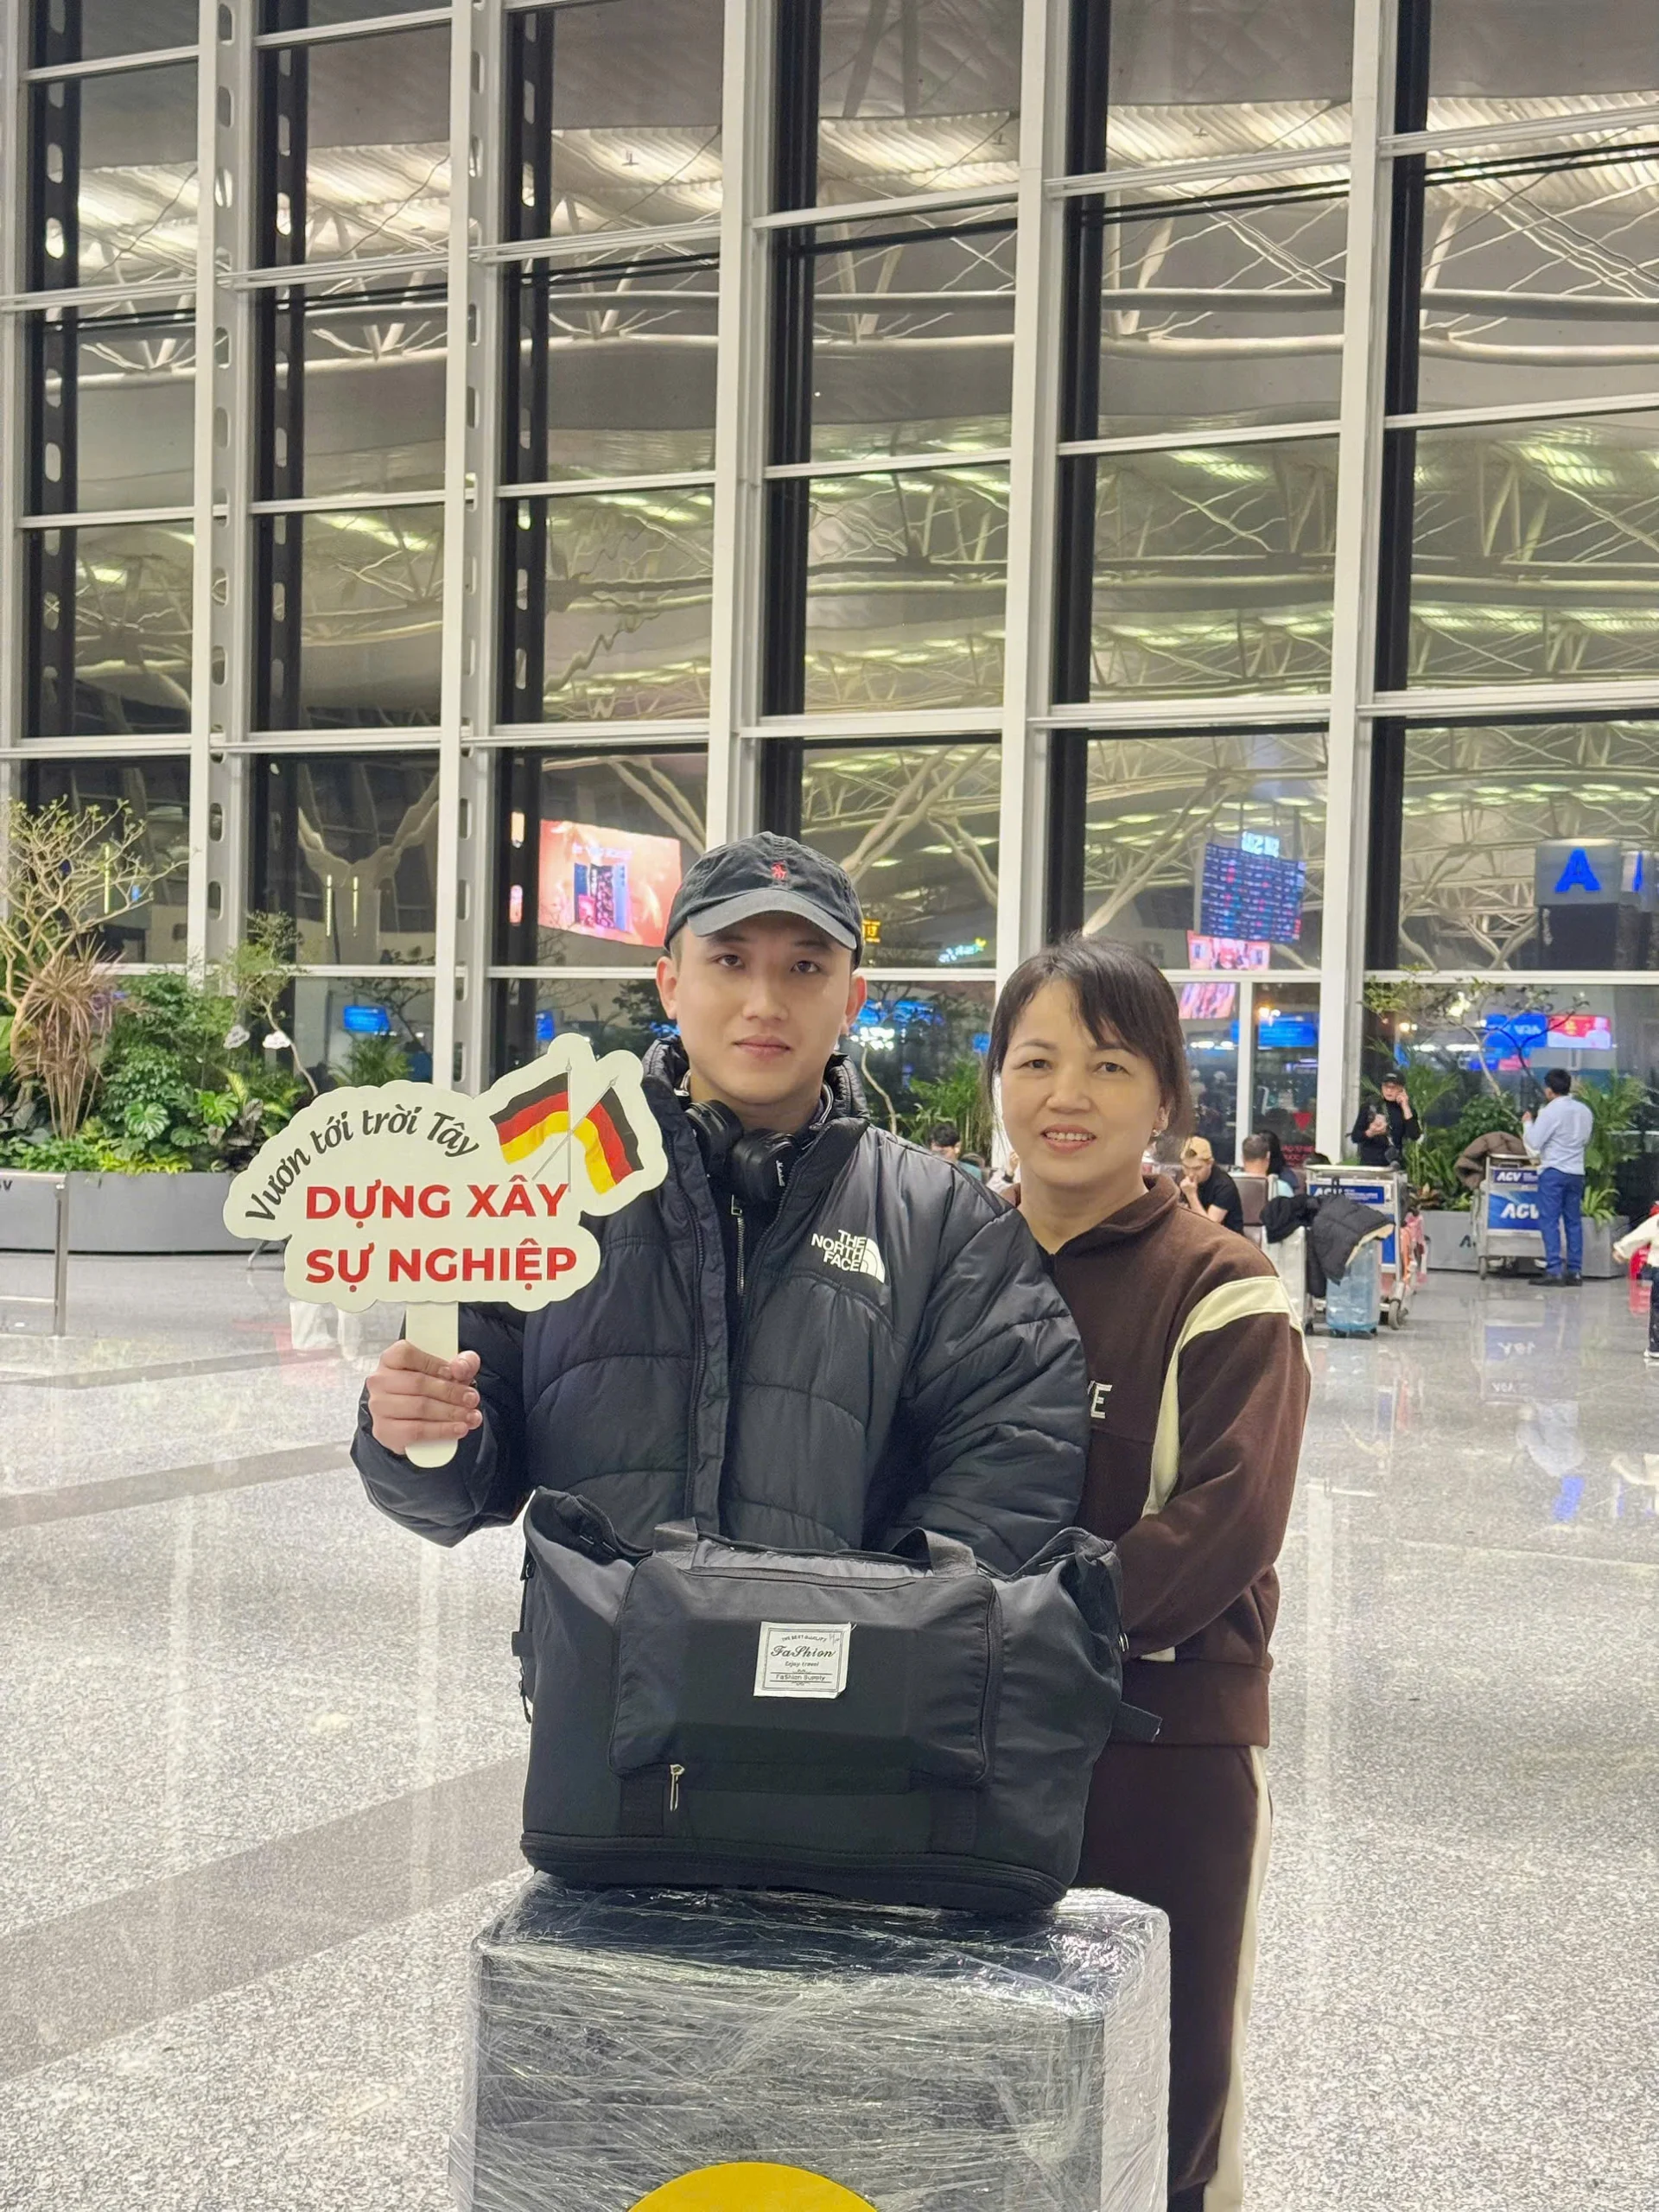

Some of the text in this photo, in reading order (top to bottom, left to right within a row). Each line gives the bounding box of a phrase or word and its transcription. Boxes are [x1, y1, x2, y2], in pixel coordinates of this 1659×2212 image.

[1554, 848, 1602, 893] A
[245, 1103, 480, 1220] Vươn tới trời Tây
[1497, 1172, 1521, 1182] ACV
[306, 1174, 569, 1229] DỰNG XÂY
[811, 1233, 864, 1261] NORTH
[838, 1229, 867, 1249] THE
[306, 1237, 577, 1293] SỰ NGHIỆP
[823, 1250, 861, 1272] FACE
